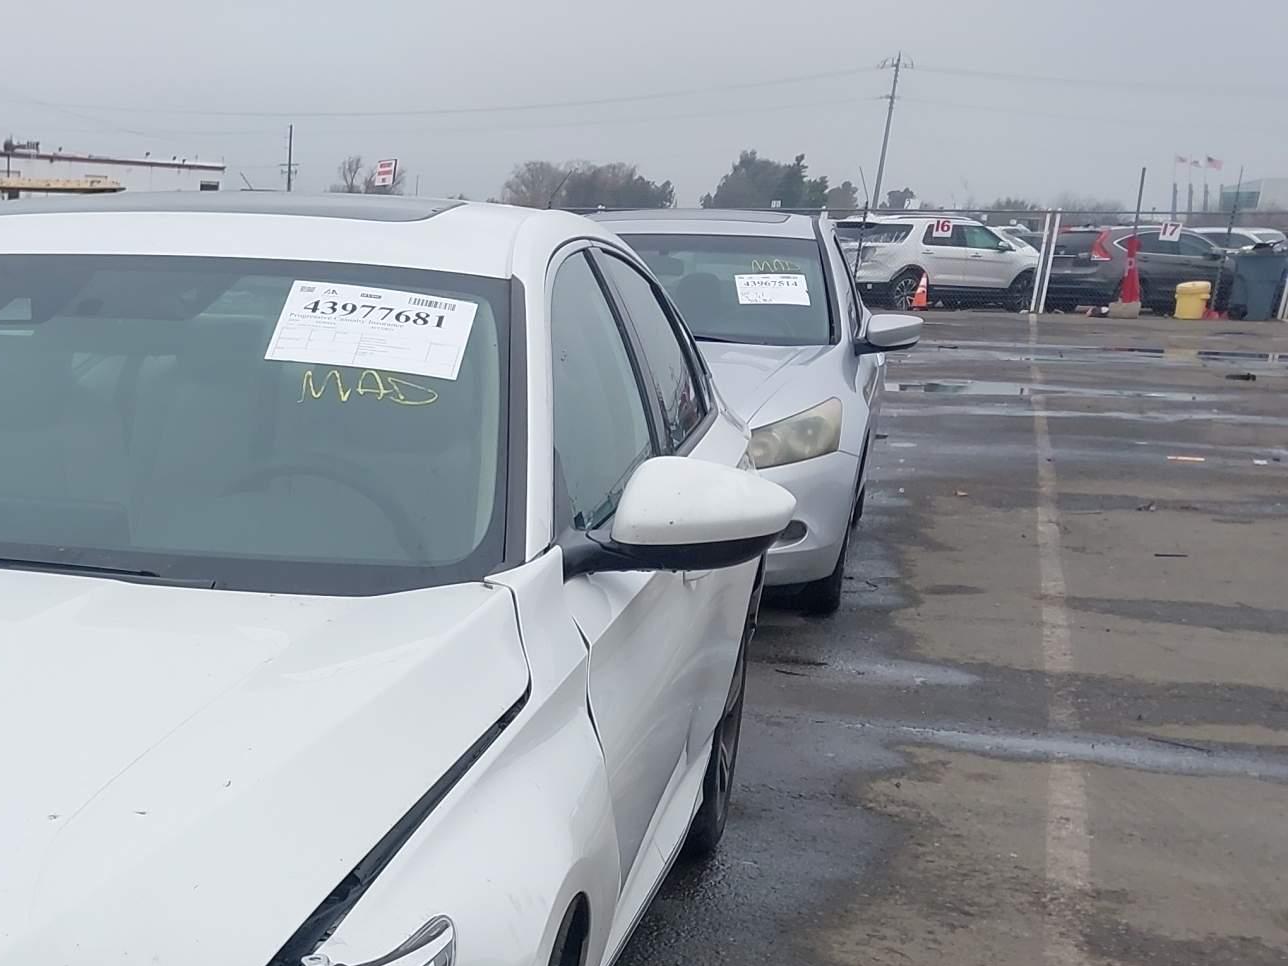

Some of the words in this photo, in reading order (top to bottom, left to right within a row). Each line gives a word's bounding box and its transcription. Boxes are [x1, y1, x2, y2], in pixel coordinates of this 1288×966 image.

[935, 219, 951, 233] 16
[1162, 223, 1180, 236] 17
[303, 299, 446, 329] 43977681
[296, 369, 439, 406] MAD
